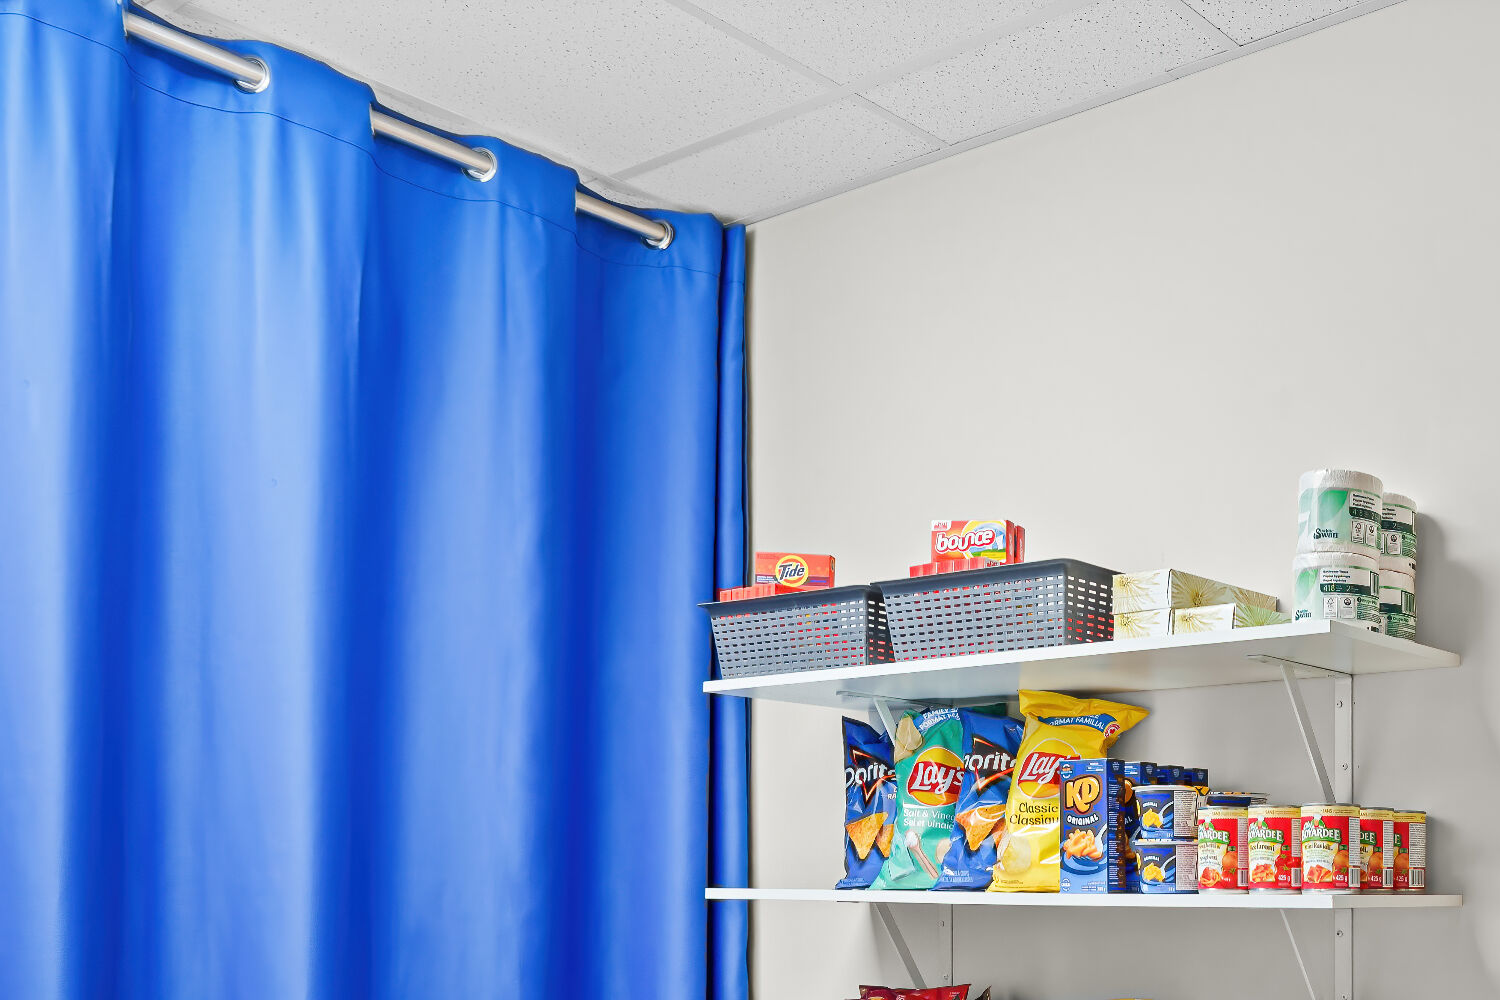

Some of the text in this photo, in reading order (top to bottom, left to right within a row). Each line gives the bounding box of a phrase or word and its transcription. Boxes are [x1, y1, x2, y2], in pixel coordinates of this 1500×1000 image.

[936, 530, 993, 551] bounce
[779, 562, 805, 581] Tide
[1075, 717, 1105, 730] FAMILIAL
[964, 752, 1017, 771] orit
[845, 762, 896, 789] Dorit
[1065, 776, 1100, 814] KD
[904, 808, 920, 818] Salt
[921, 810, 929, 818] &
[1018, 802, 1058, 814] Classic
[1010, 814, 1059, 826] Classiqu
[1066, 813, 1099, 827] ORIGINAL
